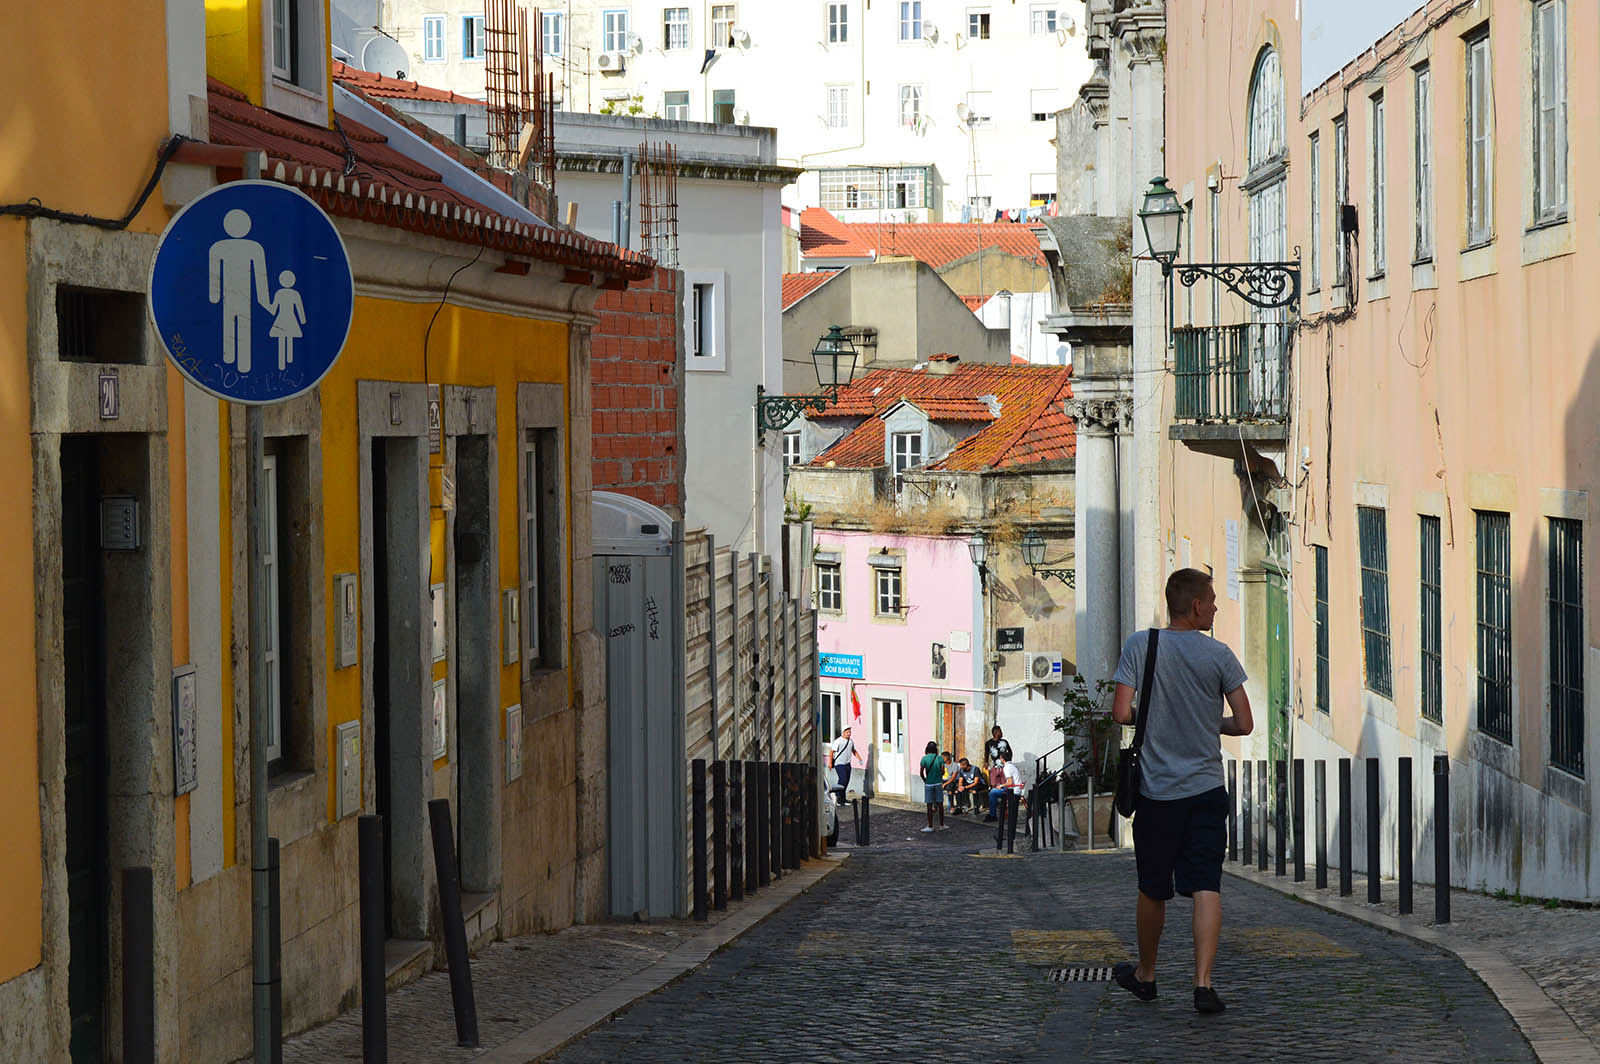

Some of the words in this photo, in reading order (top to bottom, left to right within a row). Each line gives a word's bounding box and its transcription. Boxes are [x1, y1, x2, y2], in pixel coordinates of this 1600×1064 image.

[103, 380, 115, 416] 20
[822, 656, 861, 666] STAURANTE
[825, 665, 837, 673] DOM
